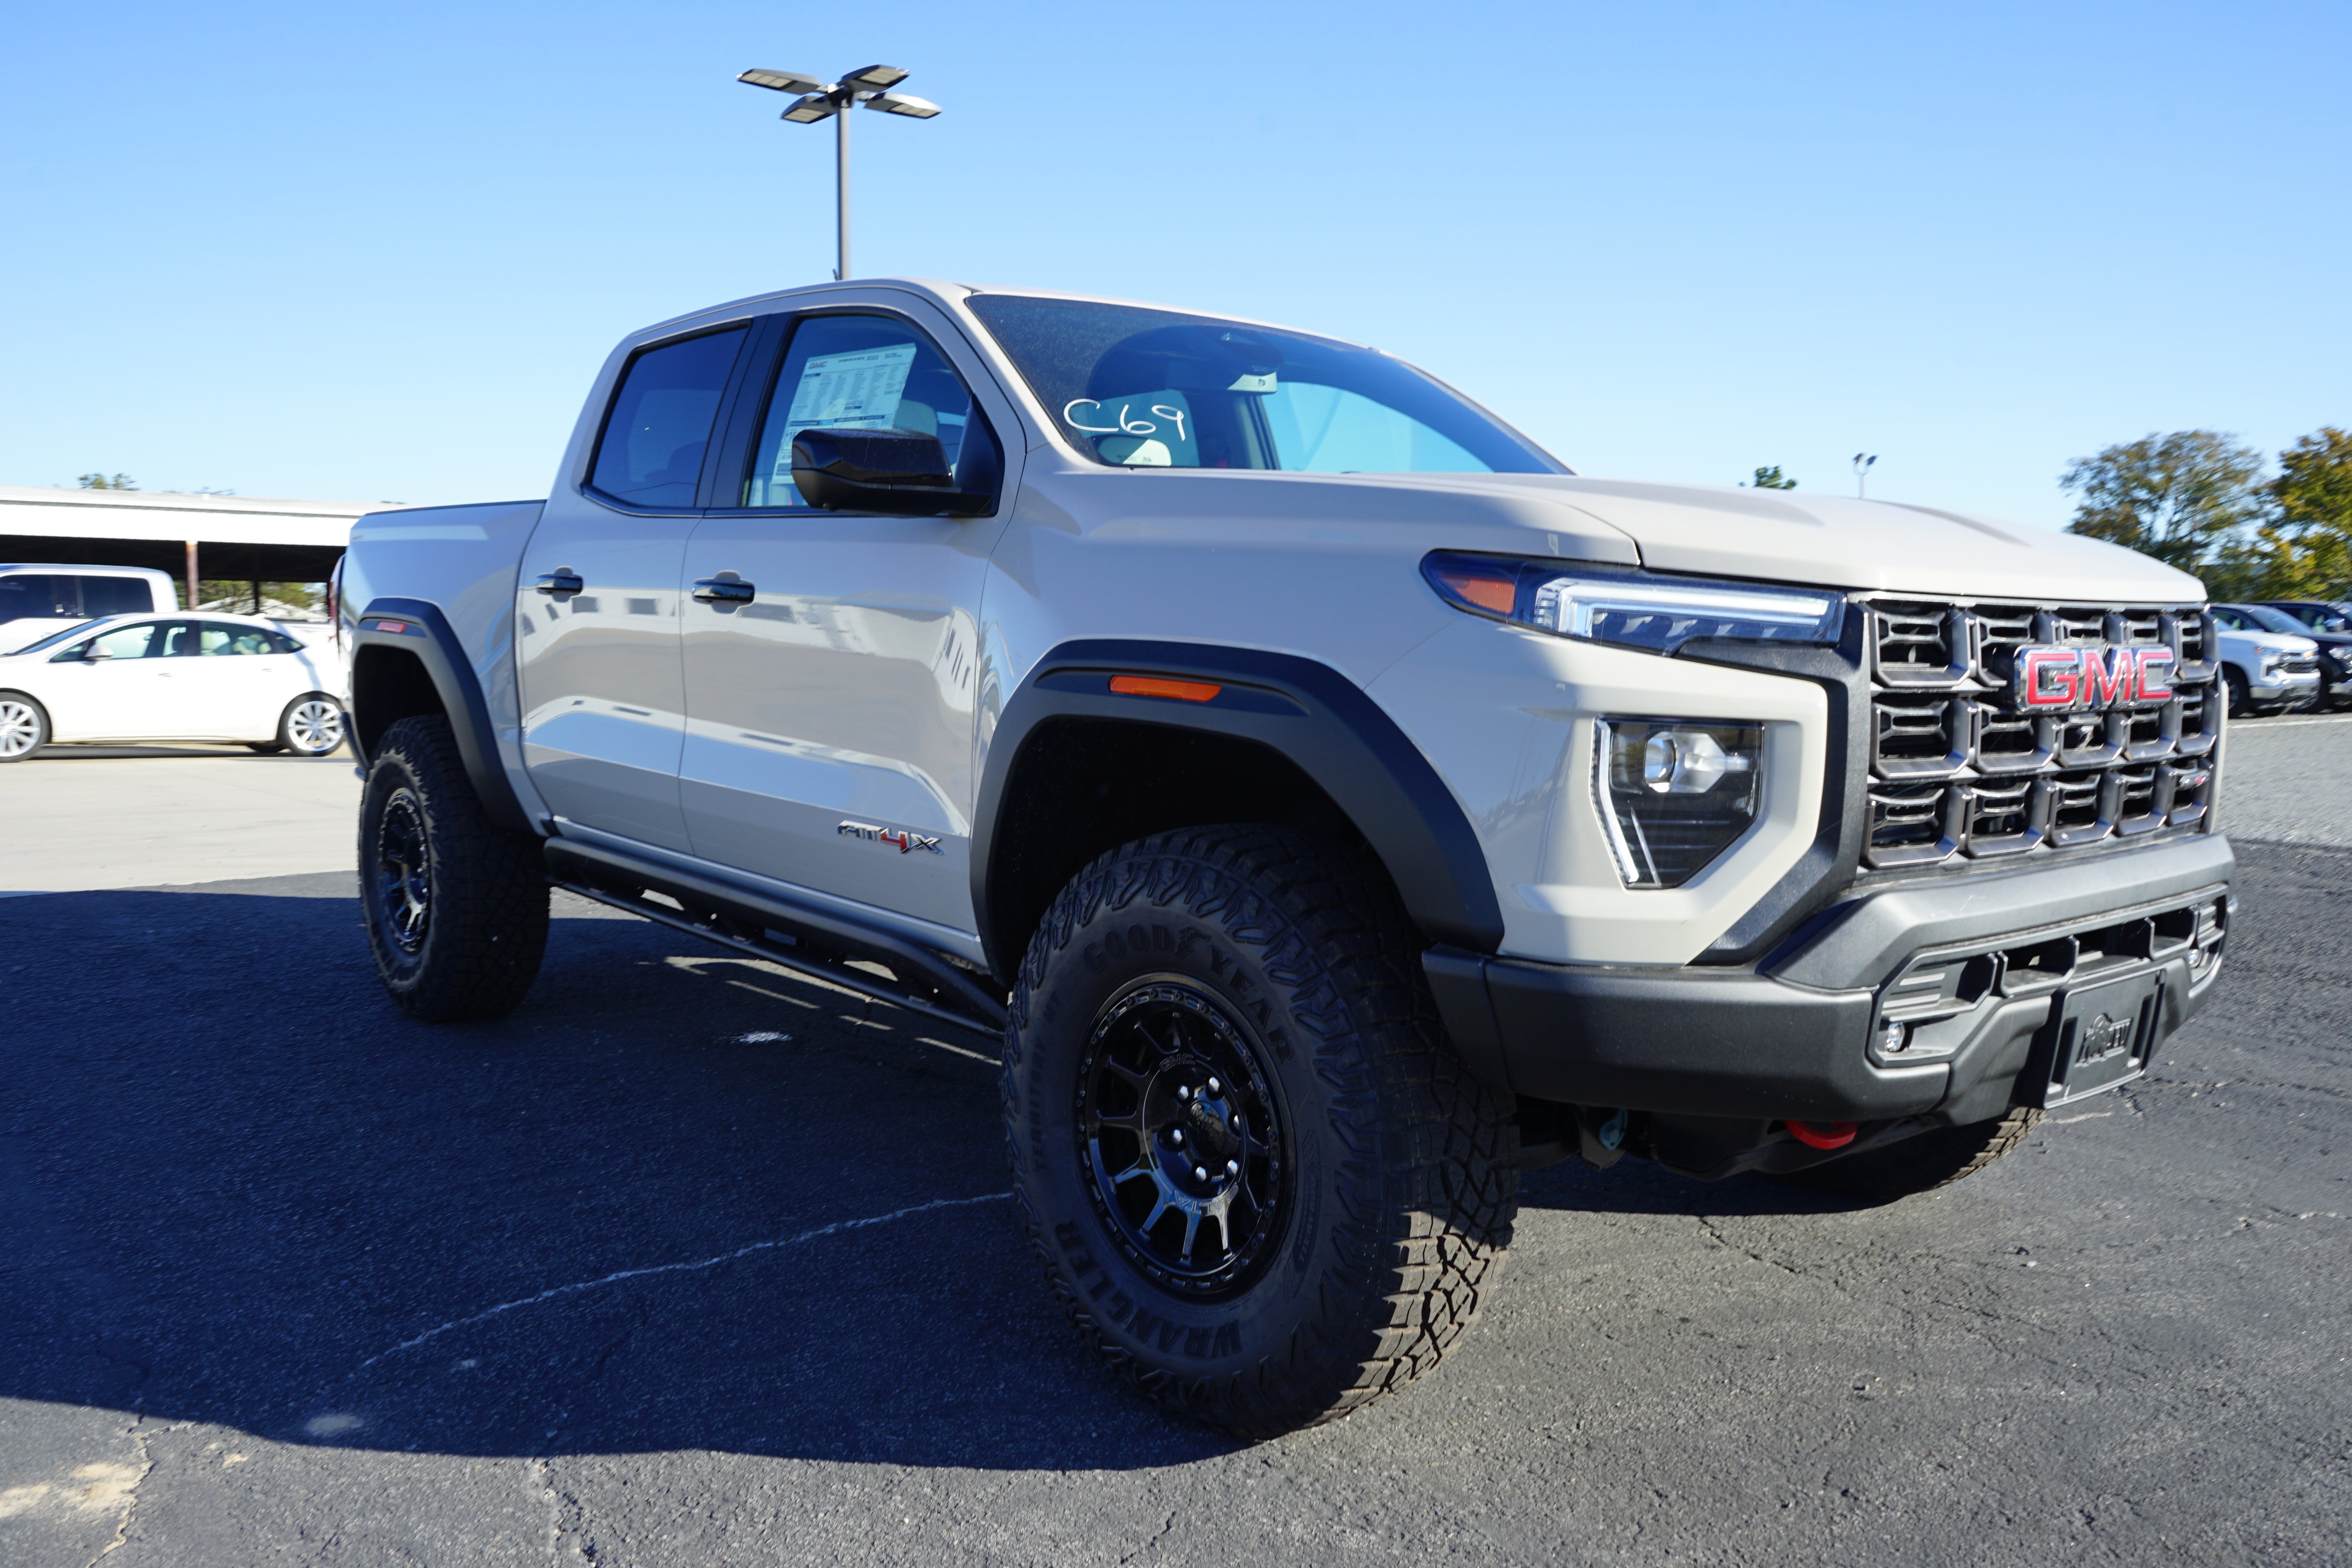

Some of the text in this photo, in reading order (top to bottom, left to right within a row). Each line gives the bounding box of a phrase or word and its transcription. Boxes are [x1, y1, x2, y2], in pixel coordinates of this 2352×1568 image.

[808, 361, 828, 369] GMC
[1063, 398, 1185, 442] C69
[2018, 646, 2174, 710] GMC
[837, 820, 945, 855] AT4X
[1159, 1053, 1196, 1073] GMC
[1029, 1036, 1047, 1172] TERRITORY
[1054, 1217, 1243, 1359] WRANGLER
